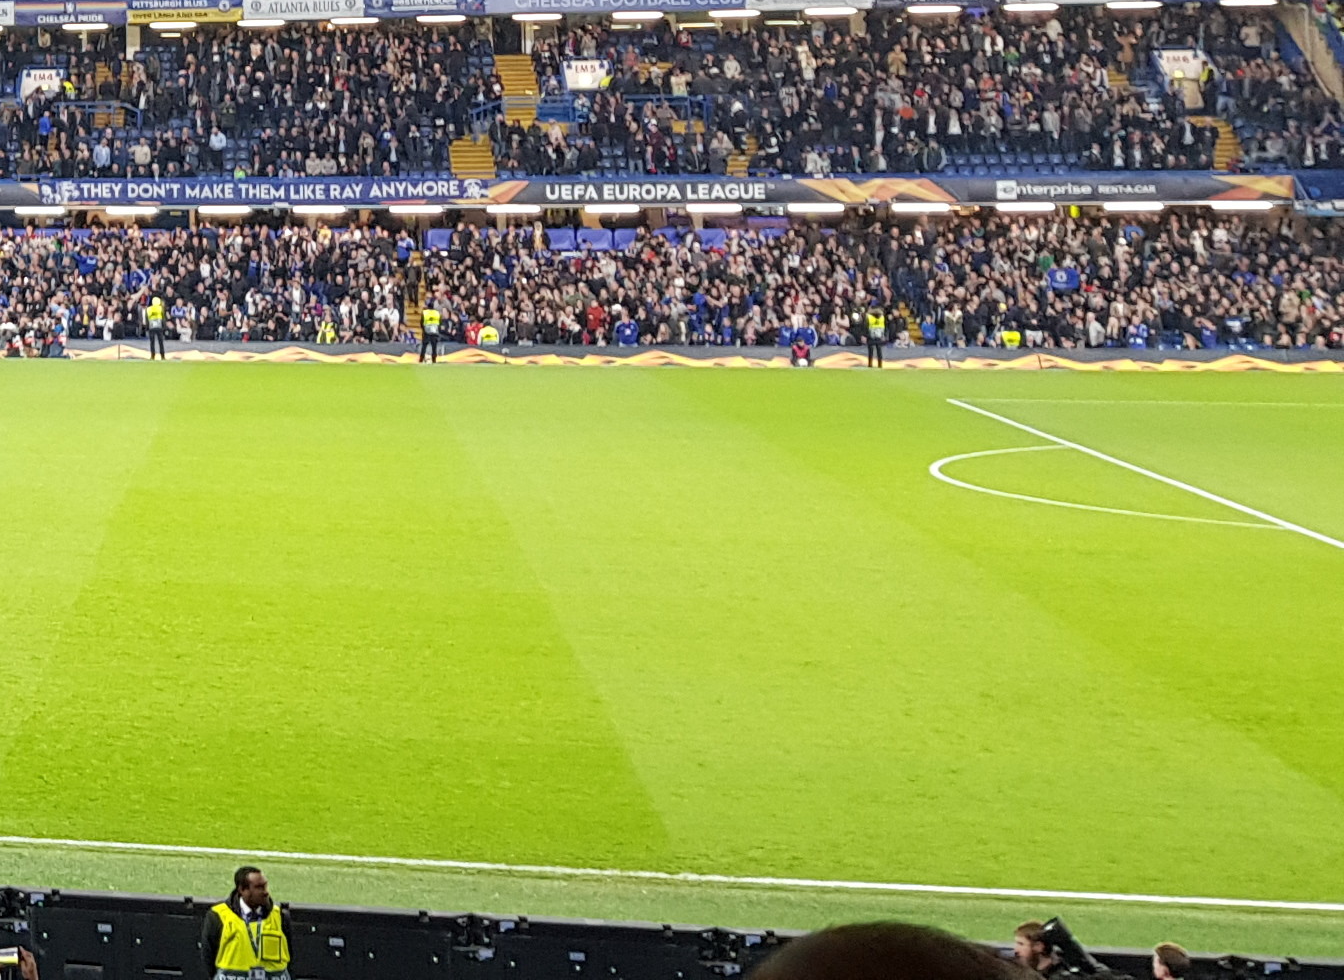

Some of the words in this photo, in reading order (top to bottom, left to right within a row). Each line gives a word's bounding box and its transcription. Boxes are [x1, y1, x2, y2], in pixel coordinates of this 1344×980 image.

[132, 0, 182, 8] PITTSBURGH
[184, 0, 208, 7] BLUES
[268, 2, 309, 13] ATLANTA
[313, 0, 341, 12] BLUES
[37, 15, 75, 23] CHELSEA
[78, 14, 104, 22] PRIDE
[80, 182, 122, 199] THEY
[127, 182, 180, 198] DON'T
[185, 184, 233, 199] MAKE
[238, 184, 284, 199] THEM
[289, 184, 325, 199] LIKE
[330, 183, 363, 198] RAY
[368, 180, 459, 198] ANYMORE
[545, 184, 598, 200] UEFA
[602, 183, 681, 200] EUROPA
[686, 182, 765, 200] LEAGUE
[1098, 184, 1156, 194] RENT-A-CAR
